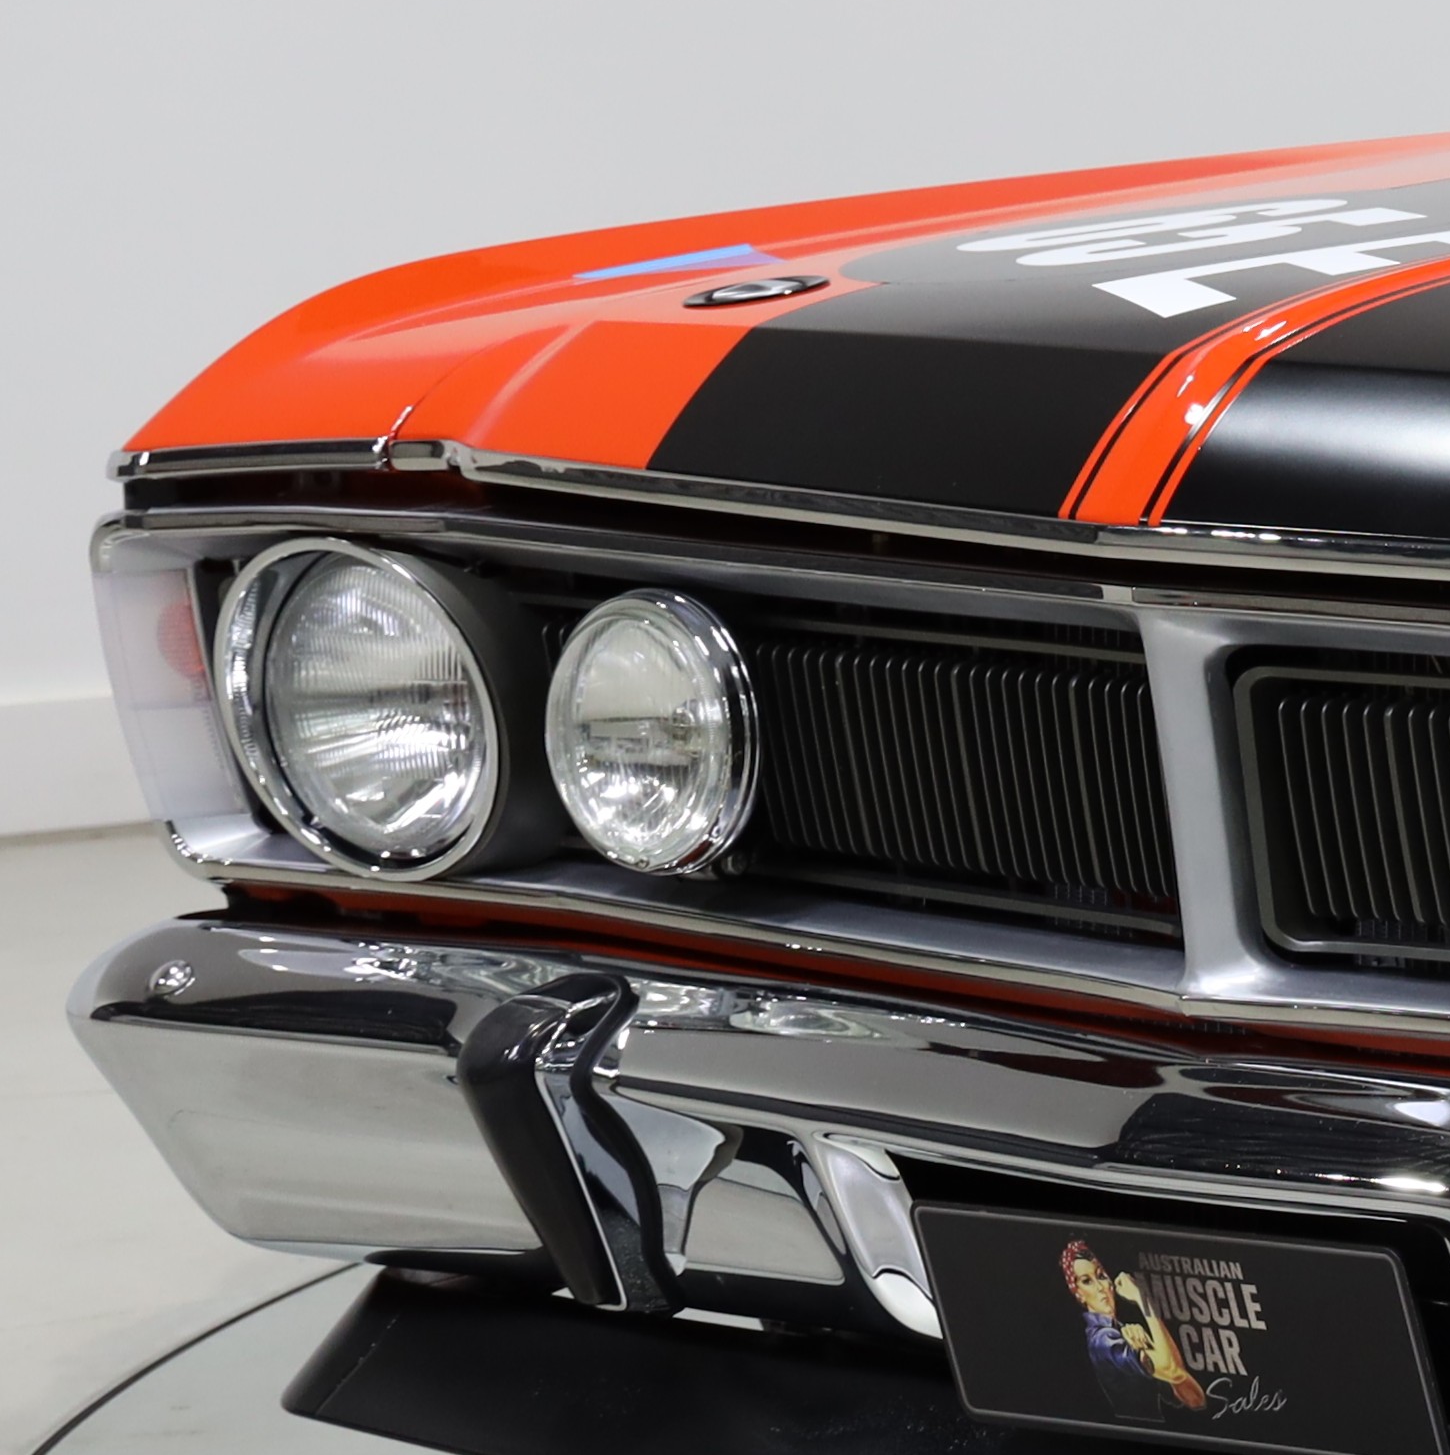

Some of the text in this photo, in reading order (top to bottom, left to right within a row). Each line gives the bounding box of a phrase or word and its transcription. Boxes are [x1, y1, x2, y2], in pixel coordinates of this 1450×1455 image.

[1137, 1252, 1245, 1282] AUSTRALIAN
[1134, 1271, 1268, 1332] MUSCLE
[1178, 1323, 1248, 1377] CAR
[1205, 1376, 1289, 1422] Sales
